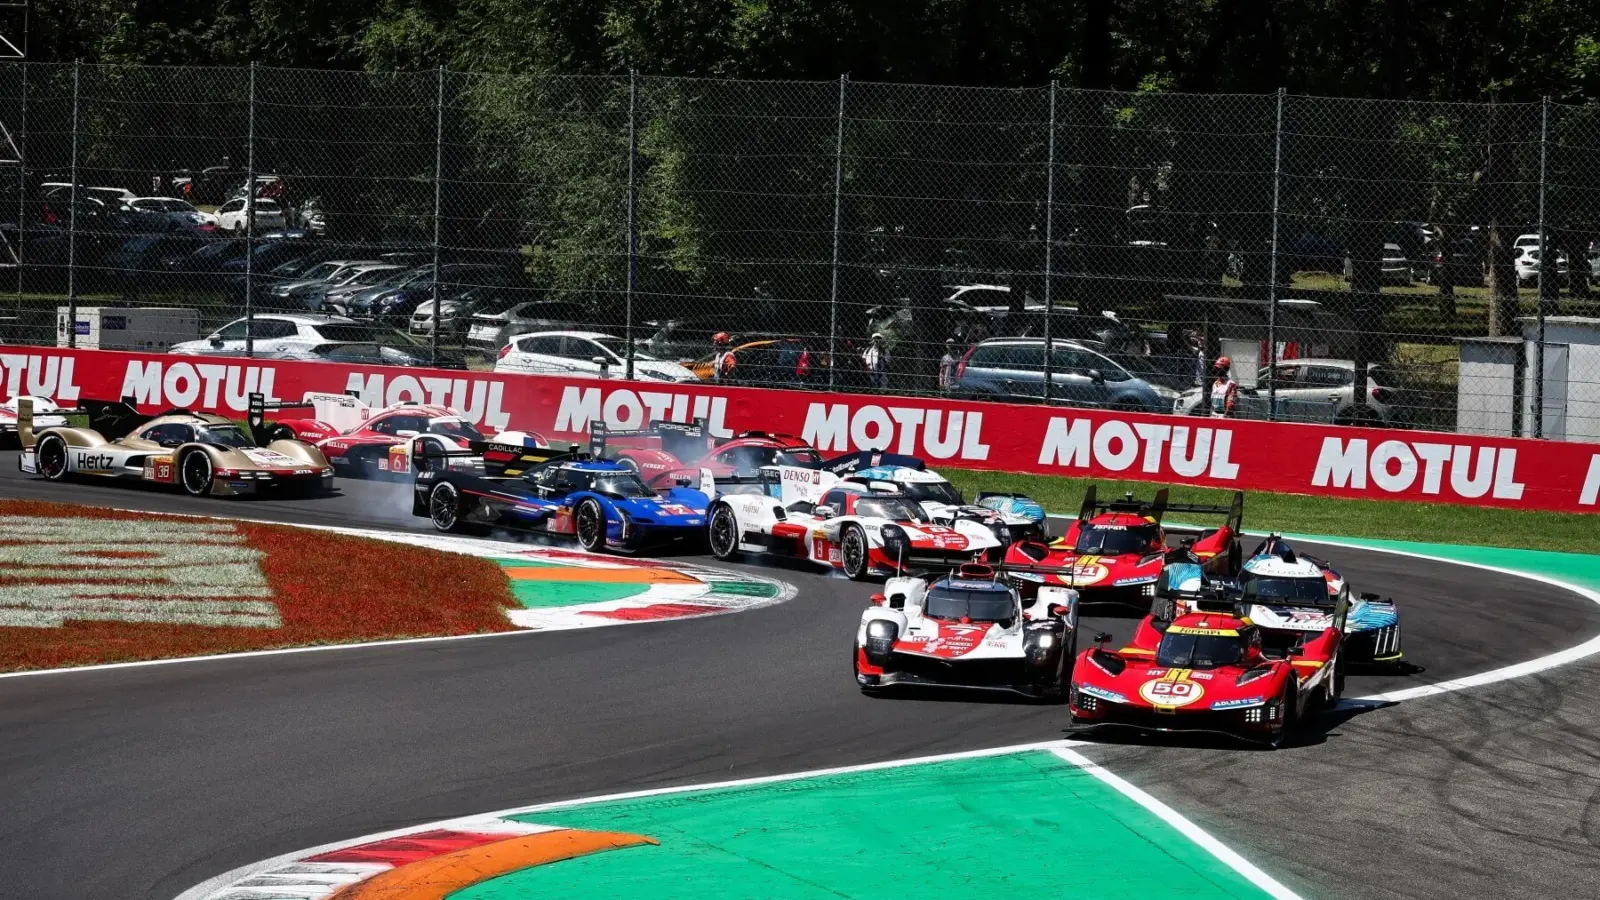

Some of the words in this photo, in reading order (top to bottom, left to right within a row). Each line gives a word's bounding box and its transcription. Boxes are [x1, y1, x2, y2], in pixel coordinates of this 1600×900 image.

[0, 353, 80, 399] TUL
[119, 360, 281, 412] MOTUL
[313, 395, 355, 404] PORSCHE
[345, 372, 511, 430] MOTUL
[658, 423, 702, 433] PORSCHE
[801, 402, 990, 460] MOTUL
[488, 443, 523, 454] CADILLAC
[1038, 416, 1240, 479] MOTUL
[77, 452, 114, 470] Hertz
[393, 455, 402, 470] 6
[1311, 437, 1525, 499] MOTUL
[157, 465, 170, 478] 38
[783, 469, 810, 483] DENSO
[1179, 627, 1221, 636] Ferrari
[1154, 684, 1192, 695] 50
[1214, 699, 1241, 707] ADLER
